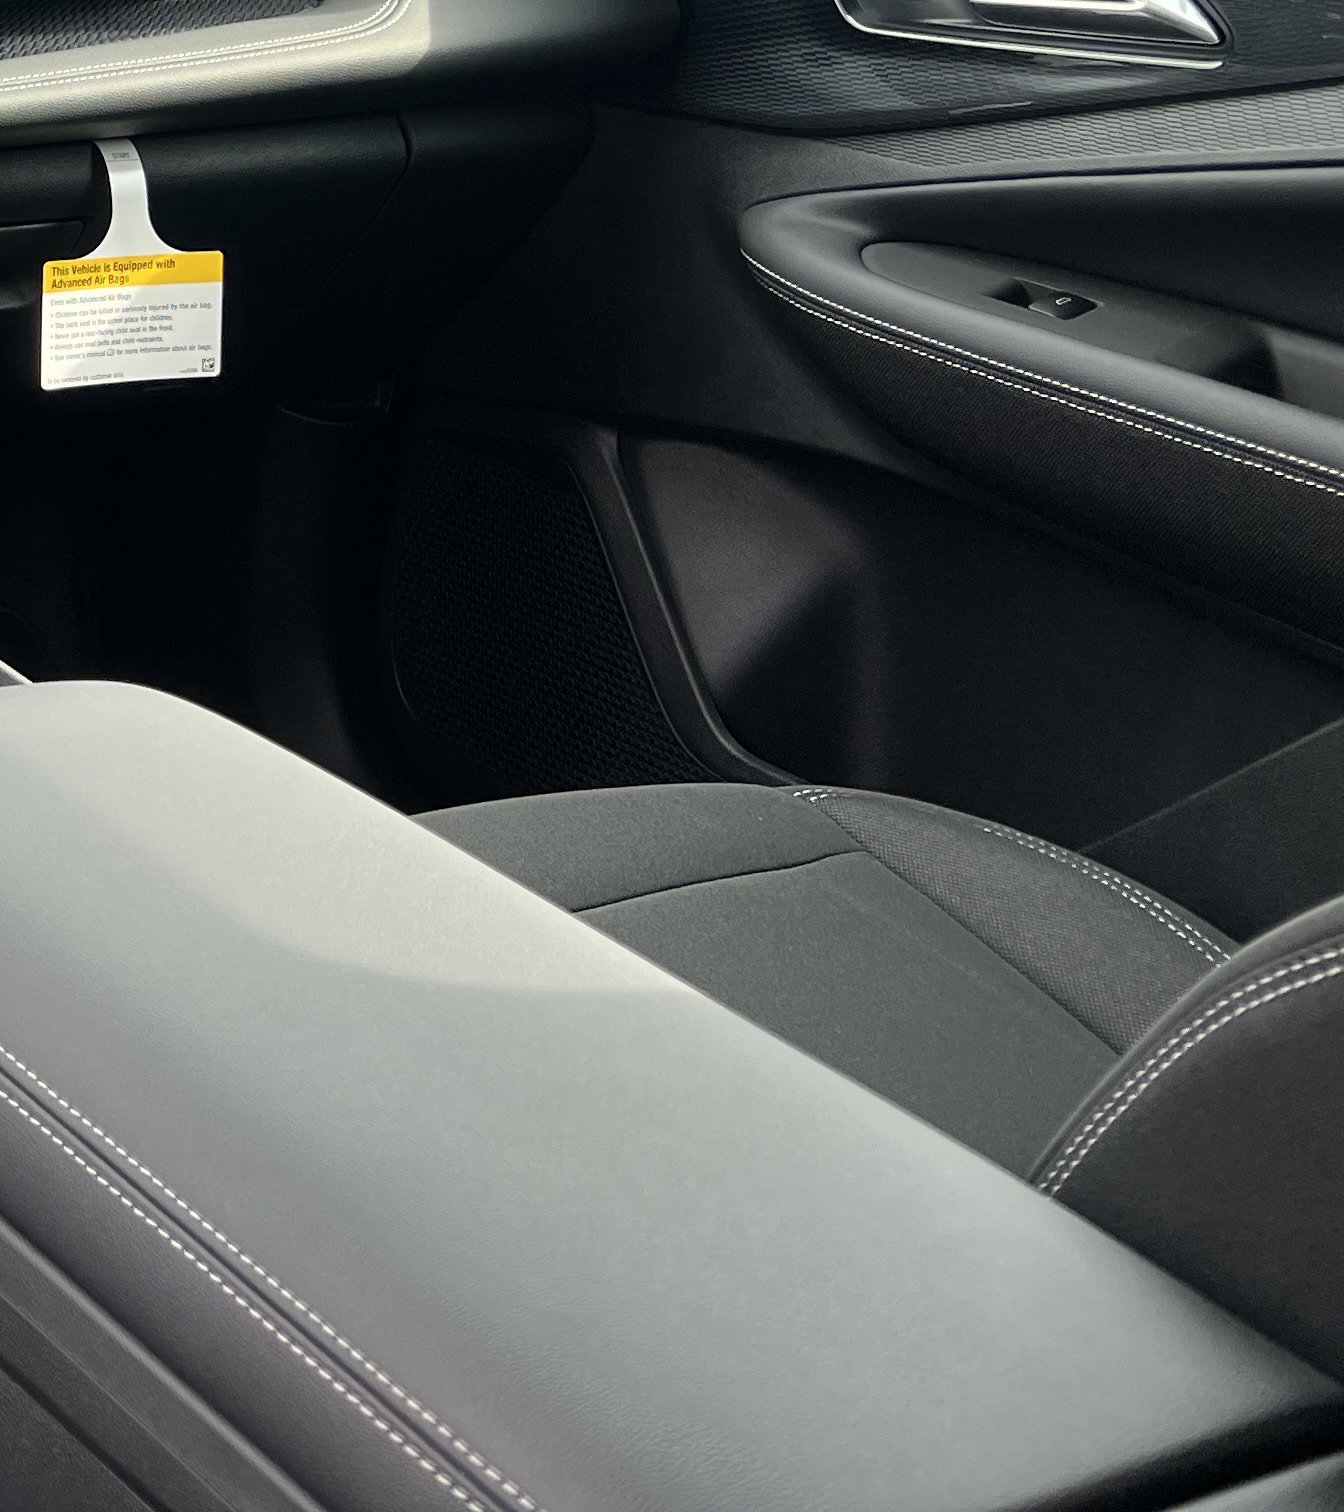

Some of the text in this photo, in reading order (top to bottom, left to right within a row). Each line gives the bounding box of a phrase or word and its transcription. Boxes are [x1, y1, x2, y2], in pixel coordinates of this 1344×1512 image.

[52, 266, 70, 277] This
[72, 263, 101, 275] Vehicle
[113, 259, 154, 273] Equipped
[156, 259, 176, 269] with
[51, 274, 130, 289] Advanced Air Bags
